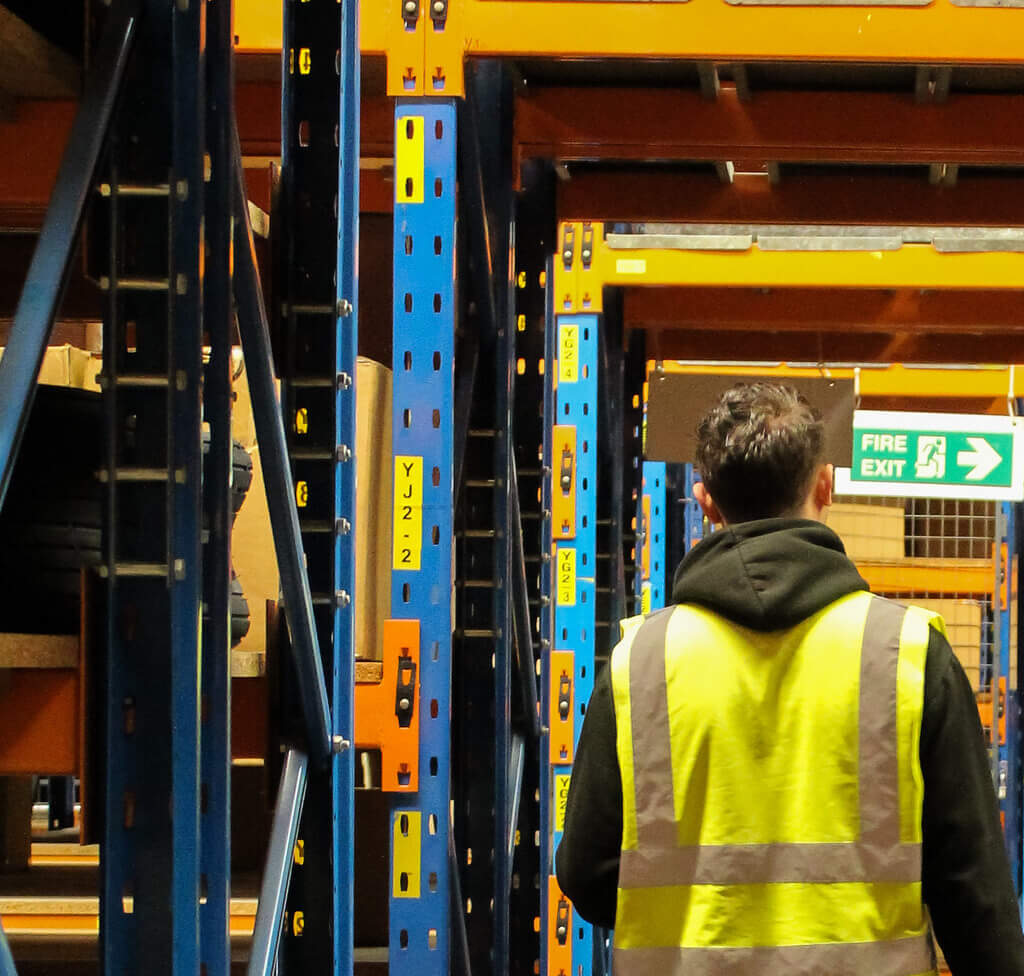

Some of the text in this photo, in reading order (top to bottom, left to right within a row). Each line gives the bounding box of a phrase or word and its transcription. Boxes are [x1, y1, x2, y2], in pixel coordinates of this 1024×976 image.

[861, 433, 908, 453] FIRE
[860, 458, 906, 478] EXIT
[401, 462, 414, 563] YJ2-2
